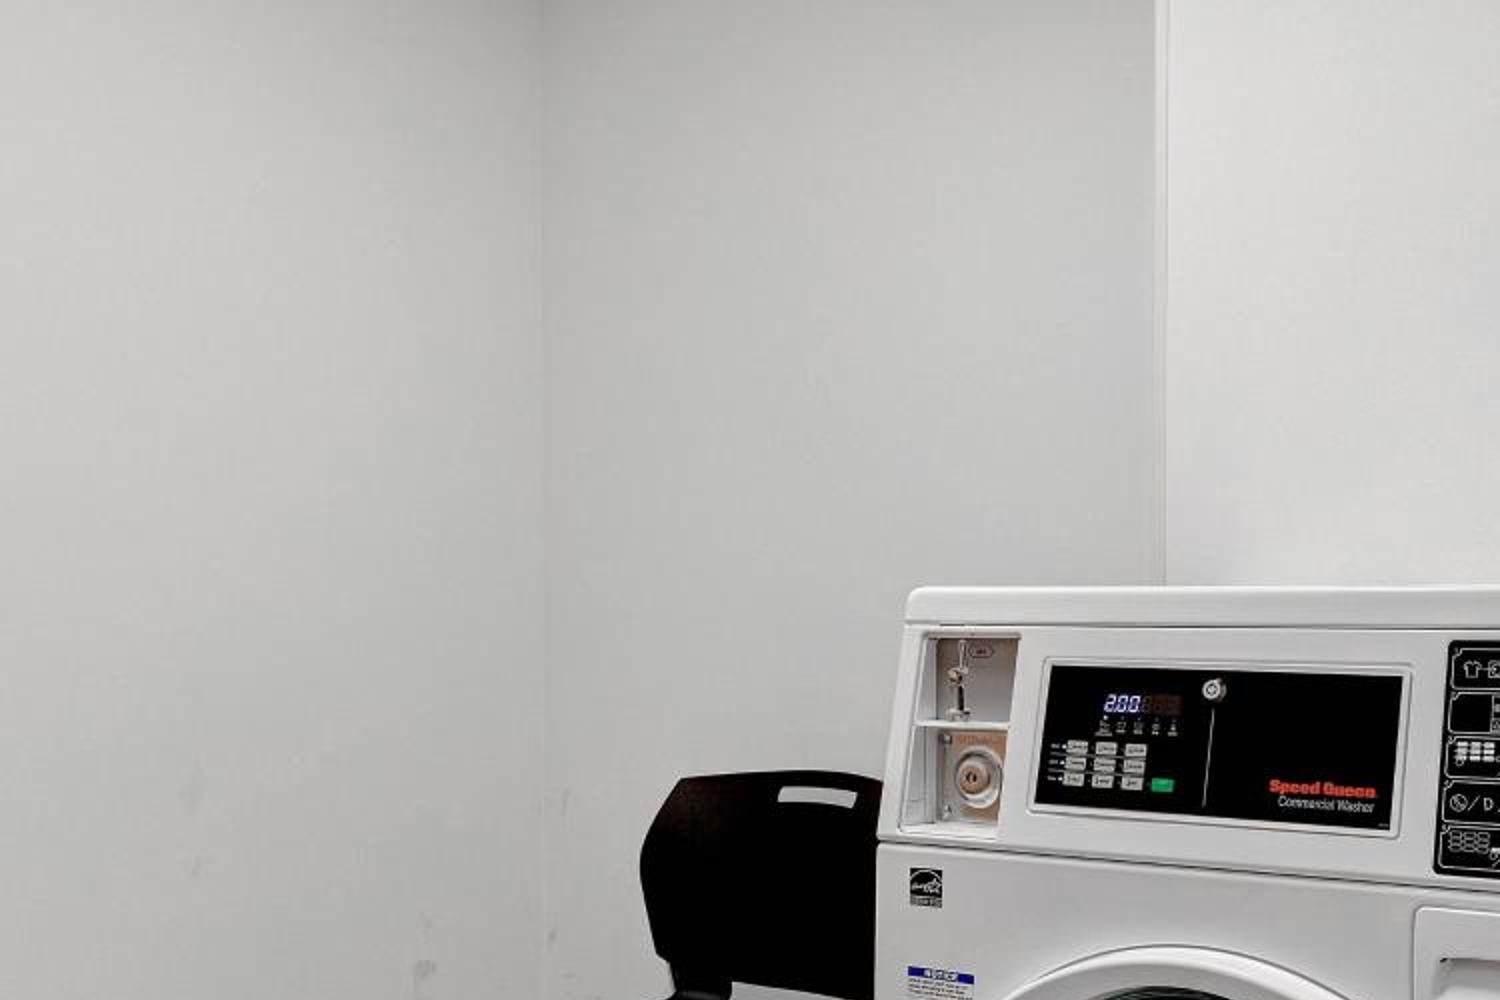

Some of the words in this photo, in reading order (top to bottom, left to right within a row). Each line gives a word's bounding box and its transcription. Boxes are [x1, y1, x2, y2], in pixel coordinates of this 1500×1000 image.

[1269, 779, 1321, 796] Speed
[1323, 782, 1377, 798] Queen
[1277, 795, 1335, 811] Commercial
[1337, 799, 1375, 813] Washer
